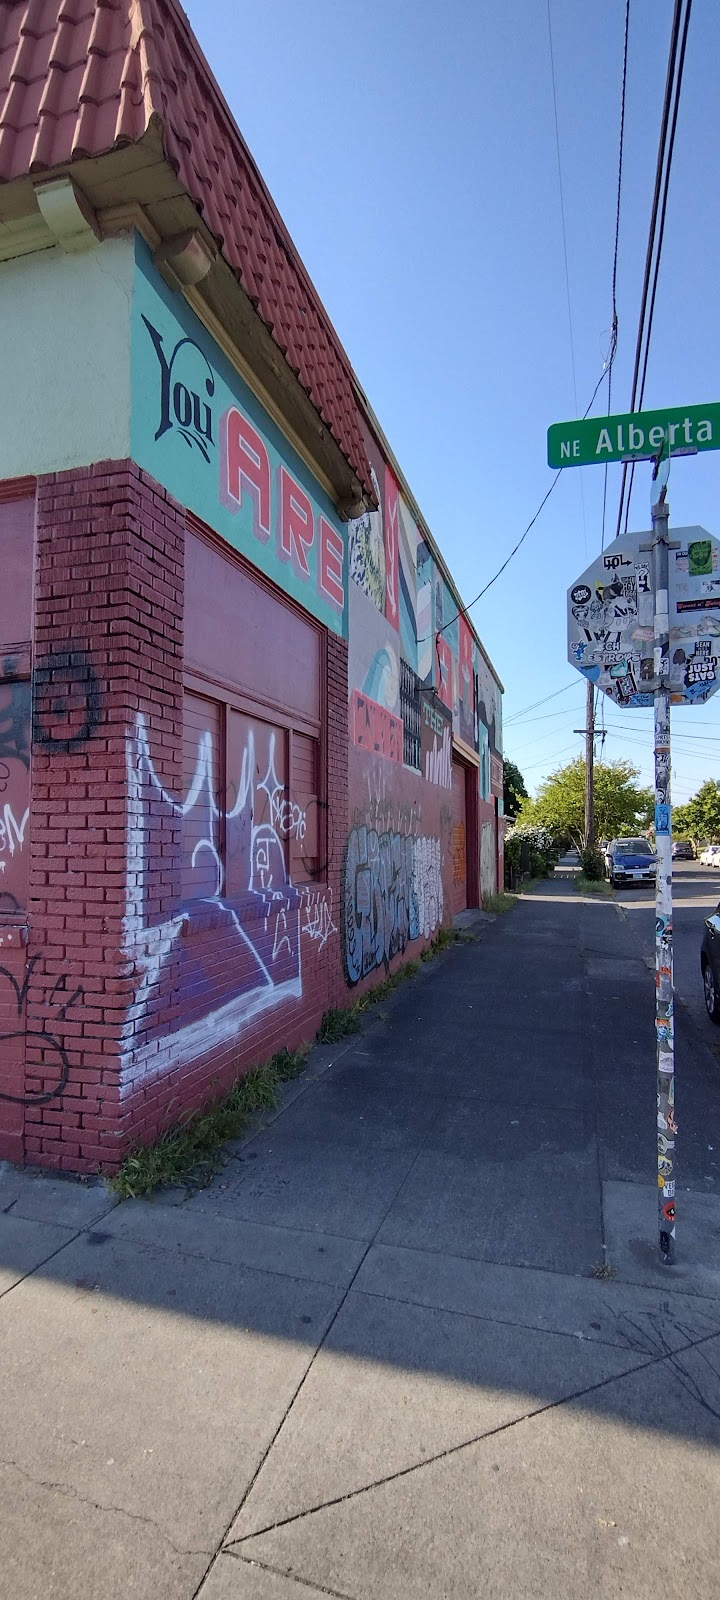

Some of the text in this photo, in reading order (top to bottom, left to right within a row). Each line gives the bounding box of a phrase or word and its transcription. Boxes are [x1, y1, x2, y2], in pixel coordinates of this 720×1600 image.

[141, 313, 215, 448] You
[560, 418, 713, 458] NE Alberta
[221, 405, 345, 610] ARE
[688, 663, 713, 674] JUST
[423, 702, 443, 736] THE
